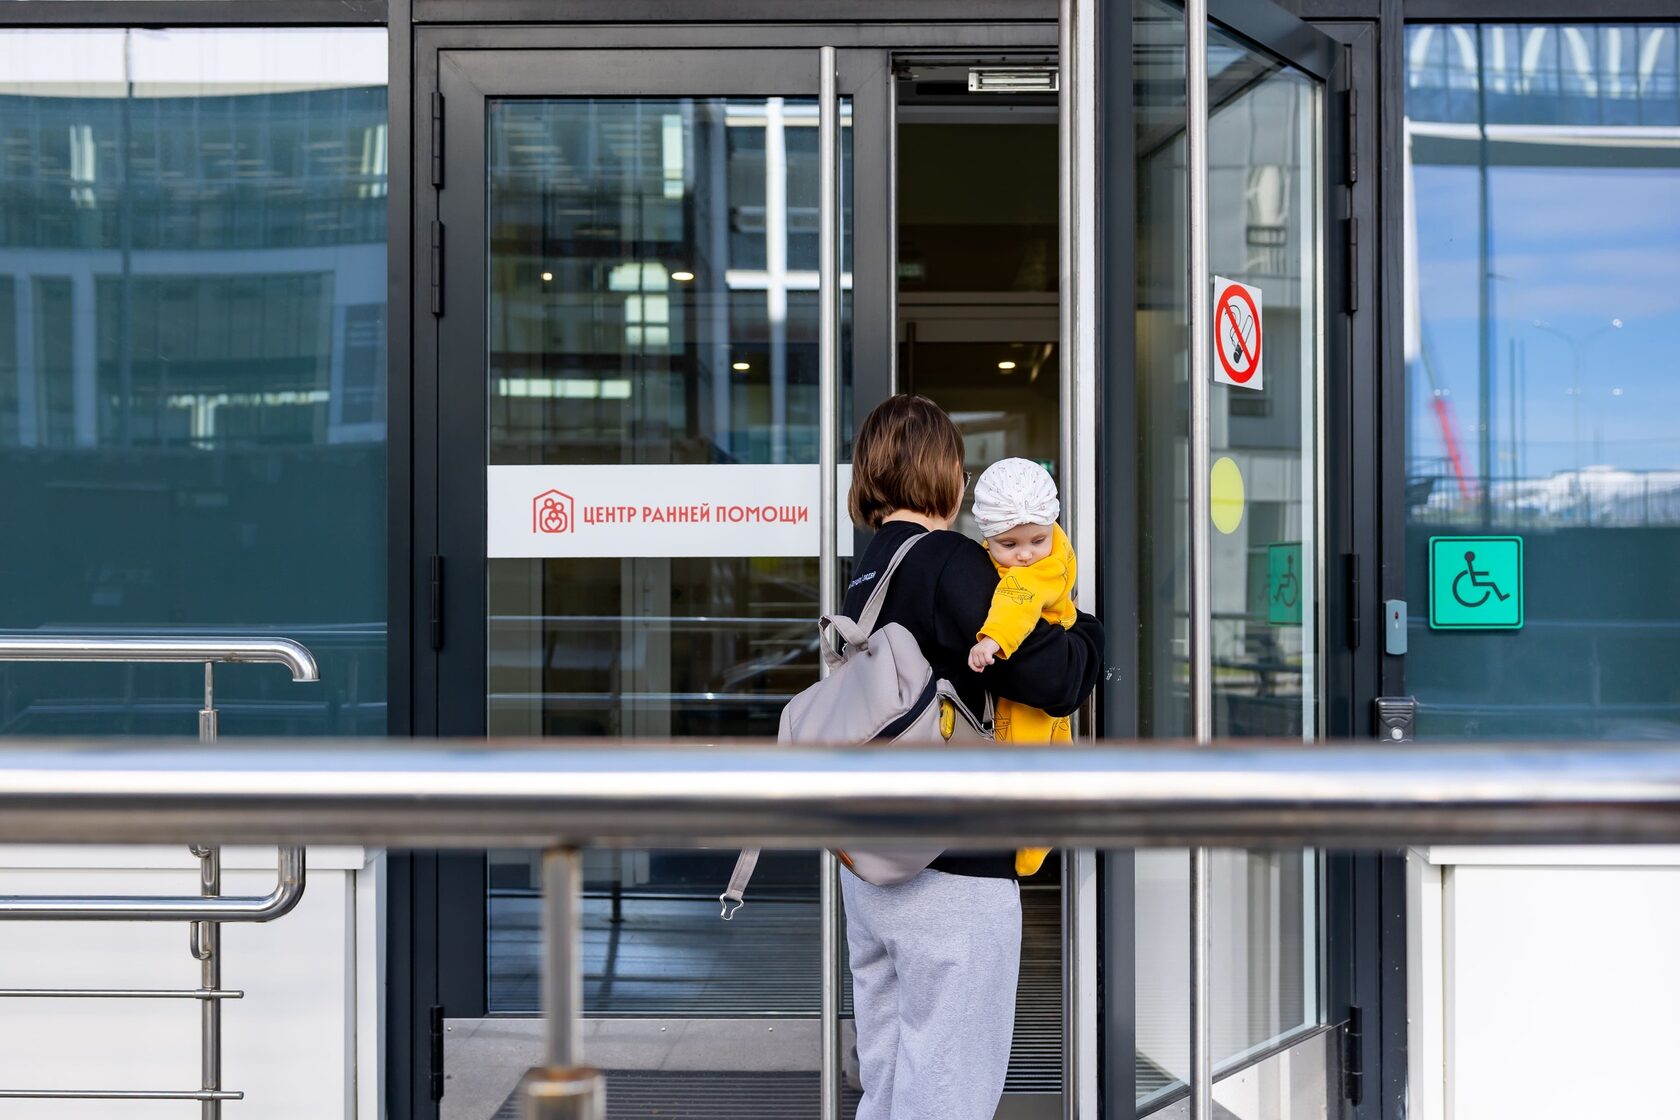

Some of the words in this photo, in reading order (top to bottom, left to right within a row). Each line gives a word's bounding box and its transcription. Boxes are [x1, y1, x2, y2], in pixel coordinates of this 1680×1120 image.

[583, 506, 636, 524] ЦЕНТР
[642, 503, 710, 523] РАННЕЙ
[716, 505, 808, 524] ПОМОЩИ
